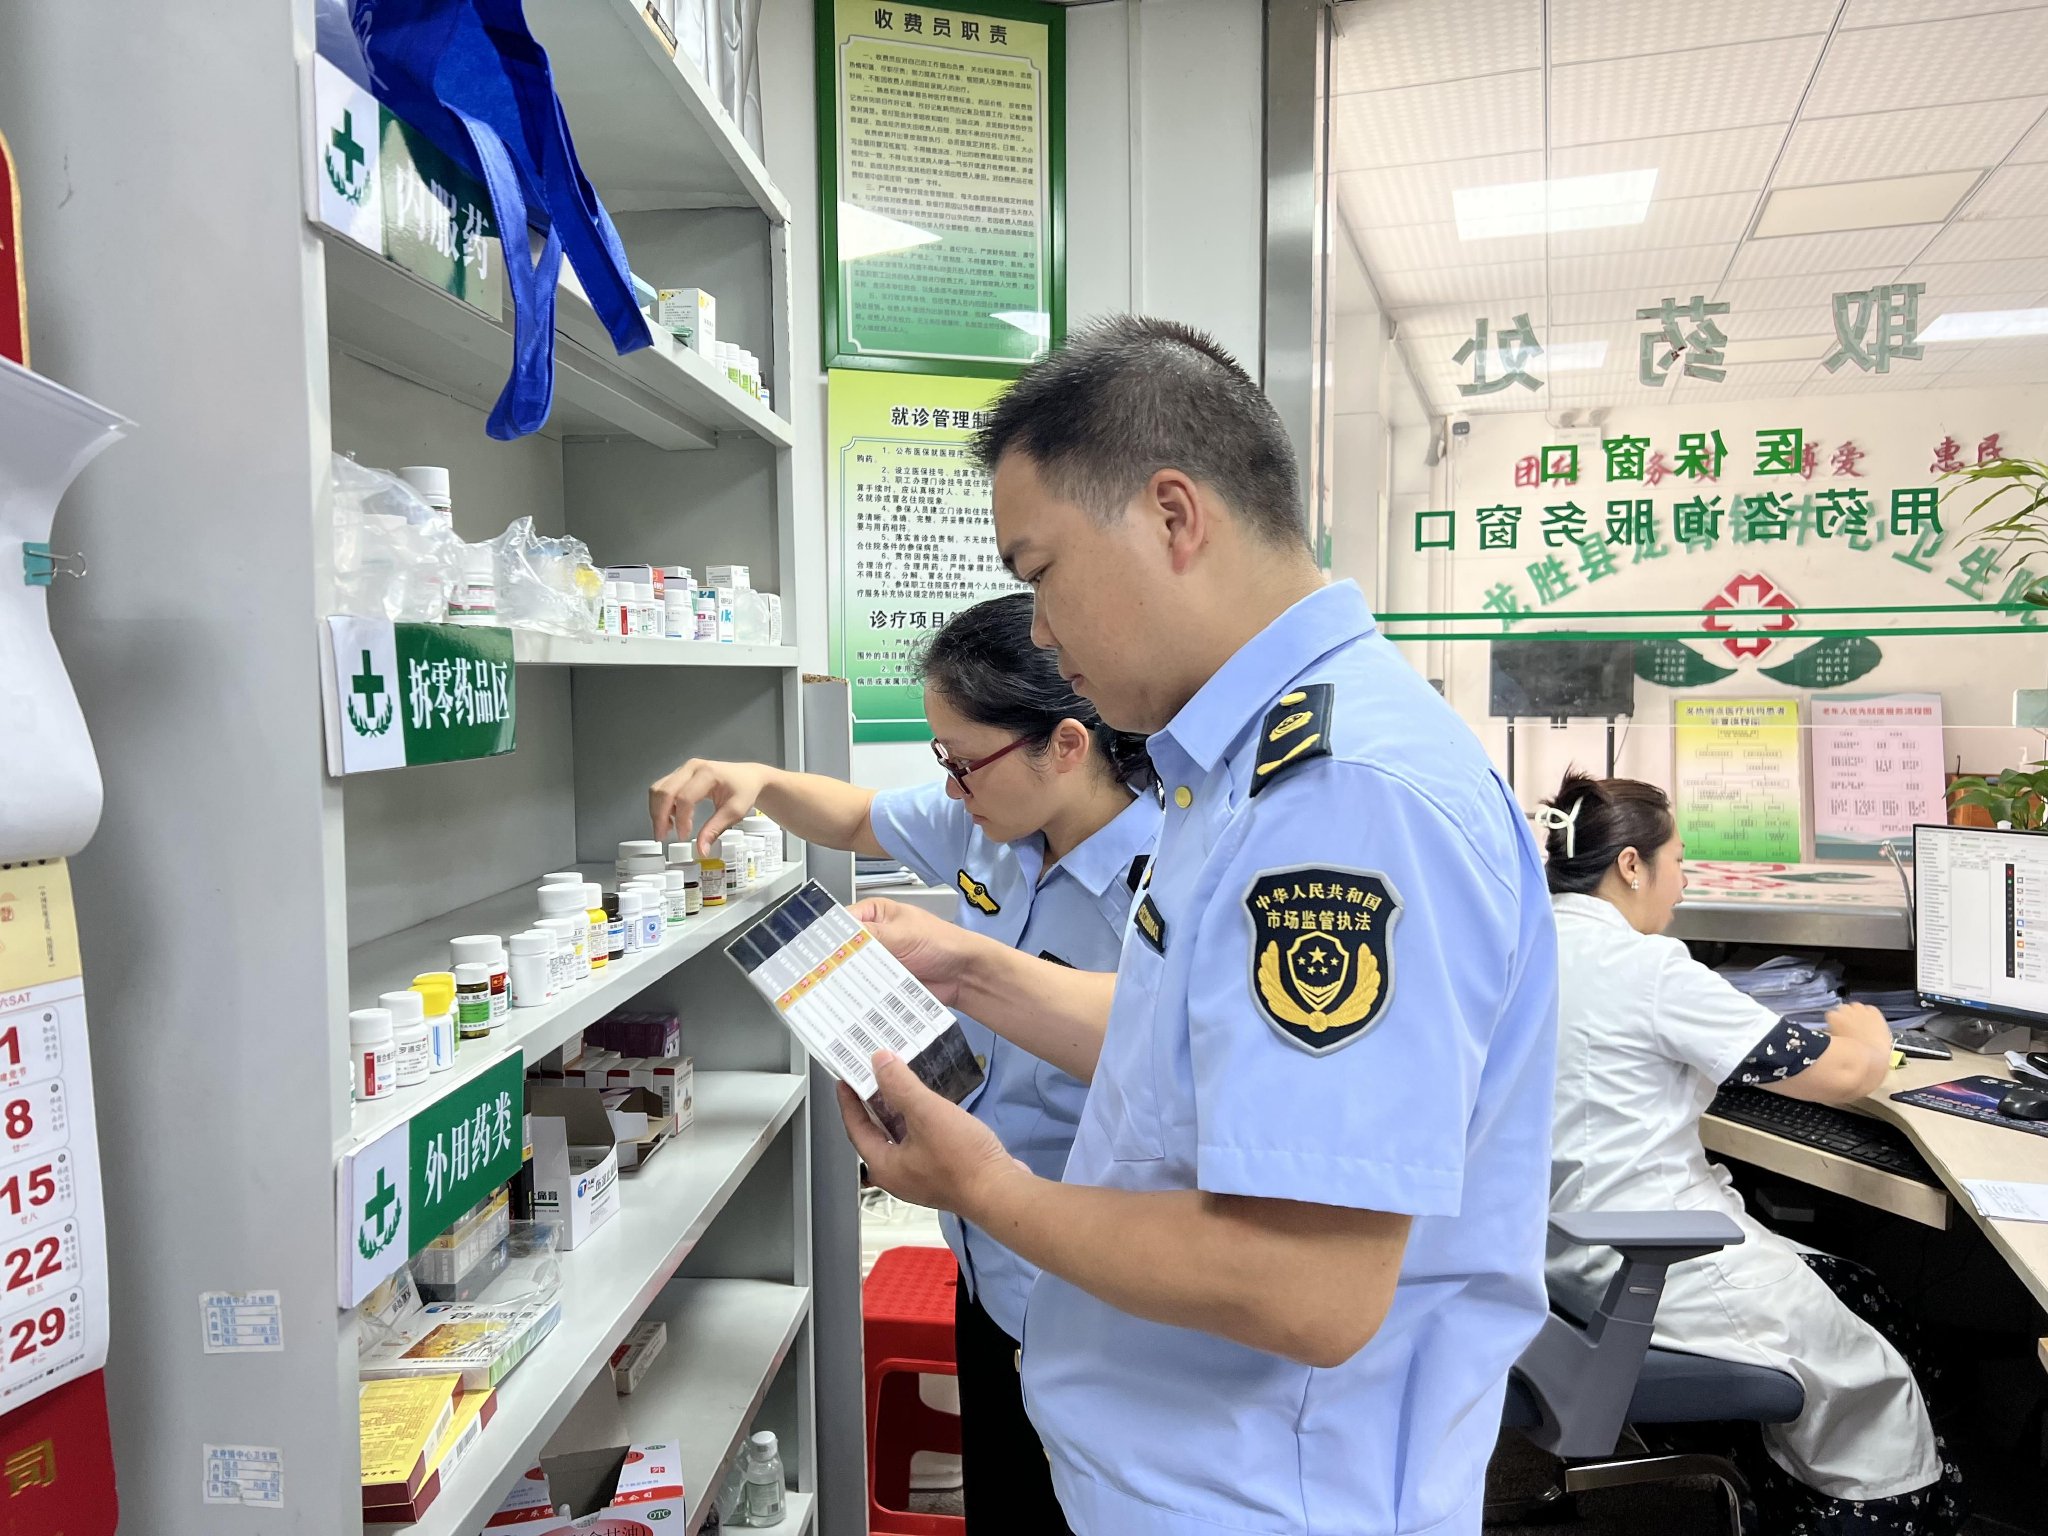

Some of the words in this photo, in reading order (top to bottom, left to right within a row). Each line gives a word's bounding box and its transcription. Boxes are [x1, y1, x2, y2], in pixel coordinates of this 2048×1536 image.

[875, 8, 1007, 45] 收费员职责
[395, 159, 488, 280] 内服药
[408, 657, 510, 729] 拆零药品区
[1256, 883, 1382, 912] 中华人民共和国
[1266, 910, 1371, 931] 市场监管执法
[5, 1099, 33, 1139] 8
[424, 1091, 511, 1207] 外用药类
[0, 1163, 55, 1215] 15
[5, 1236, 62, 1292] 22
[9, 1307, 65, 1363] 29
[648, 1509, 669, 1519] OTC
